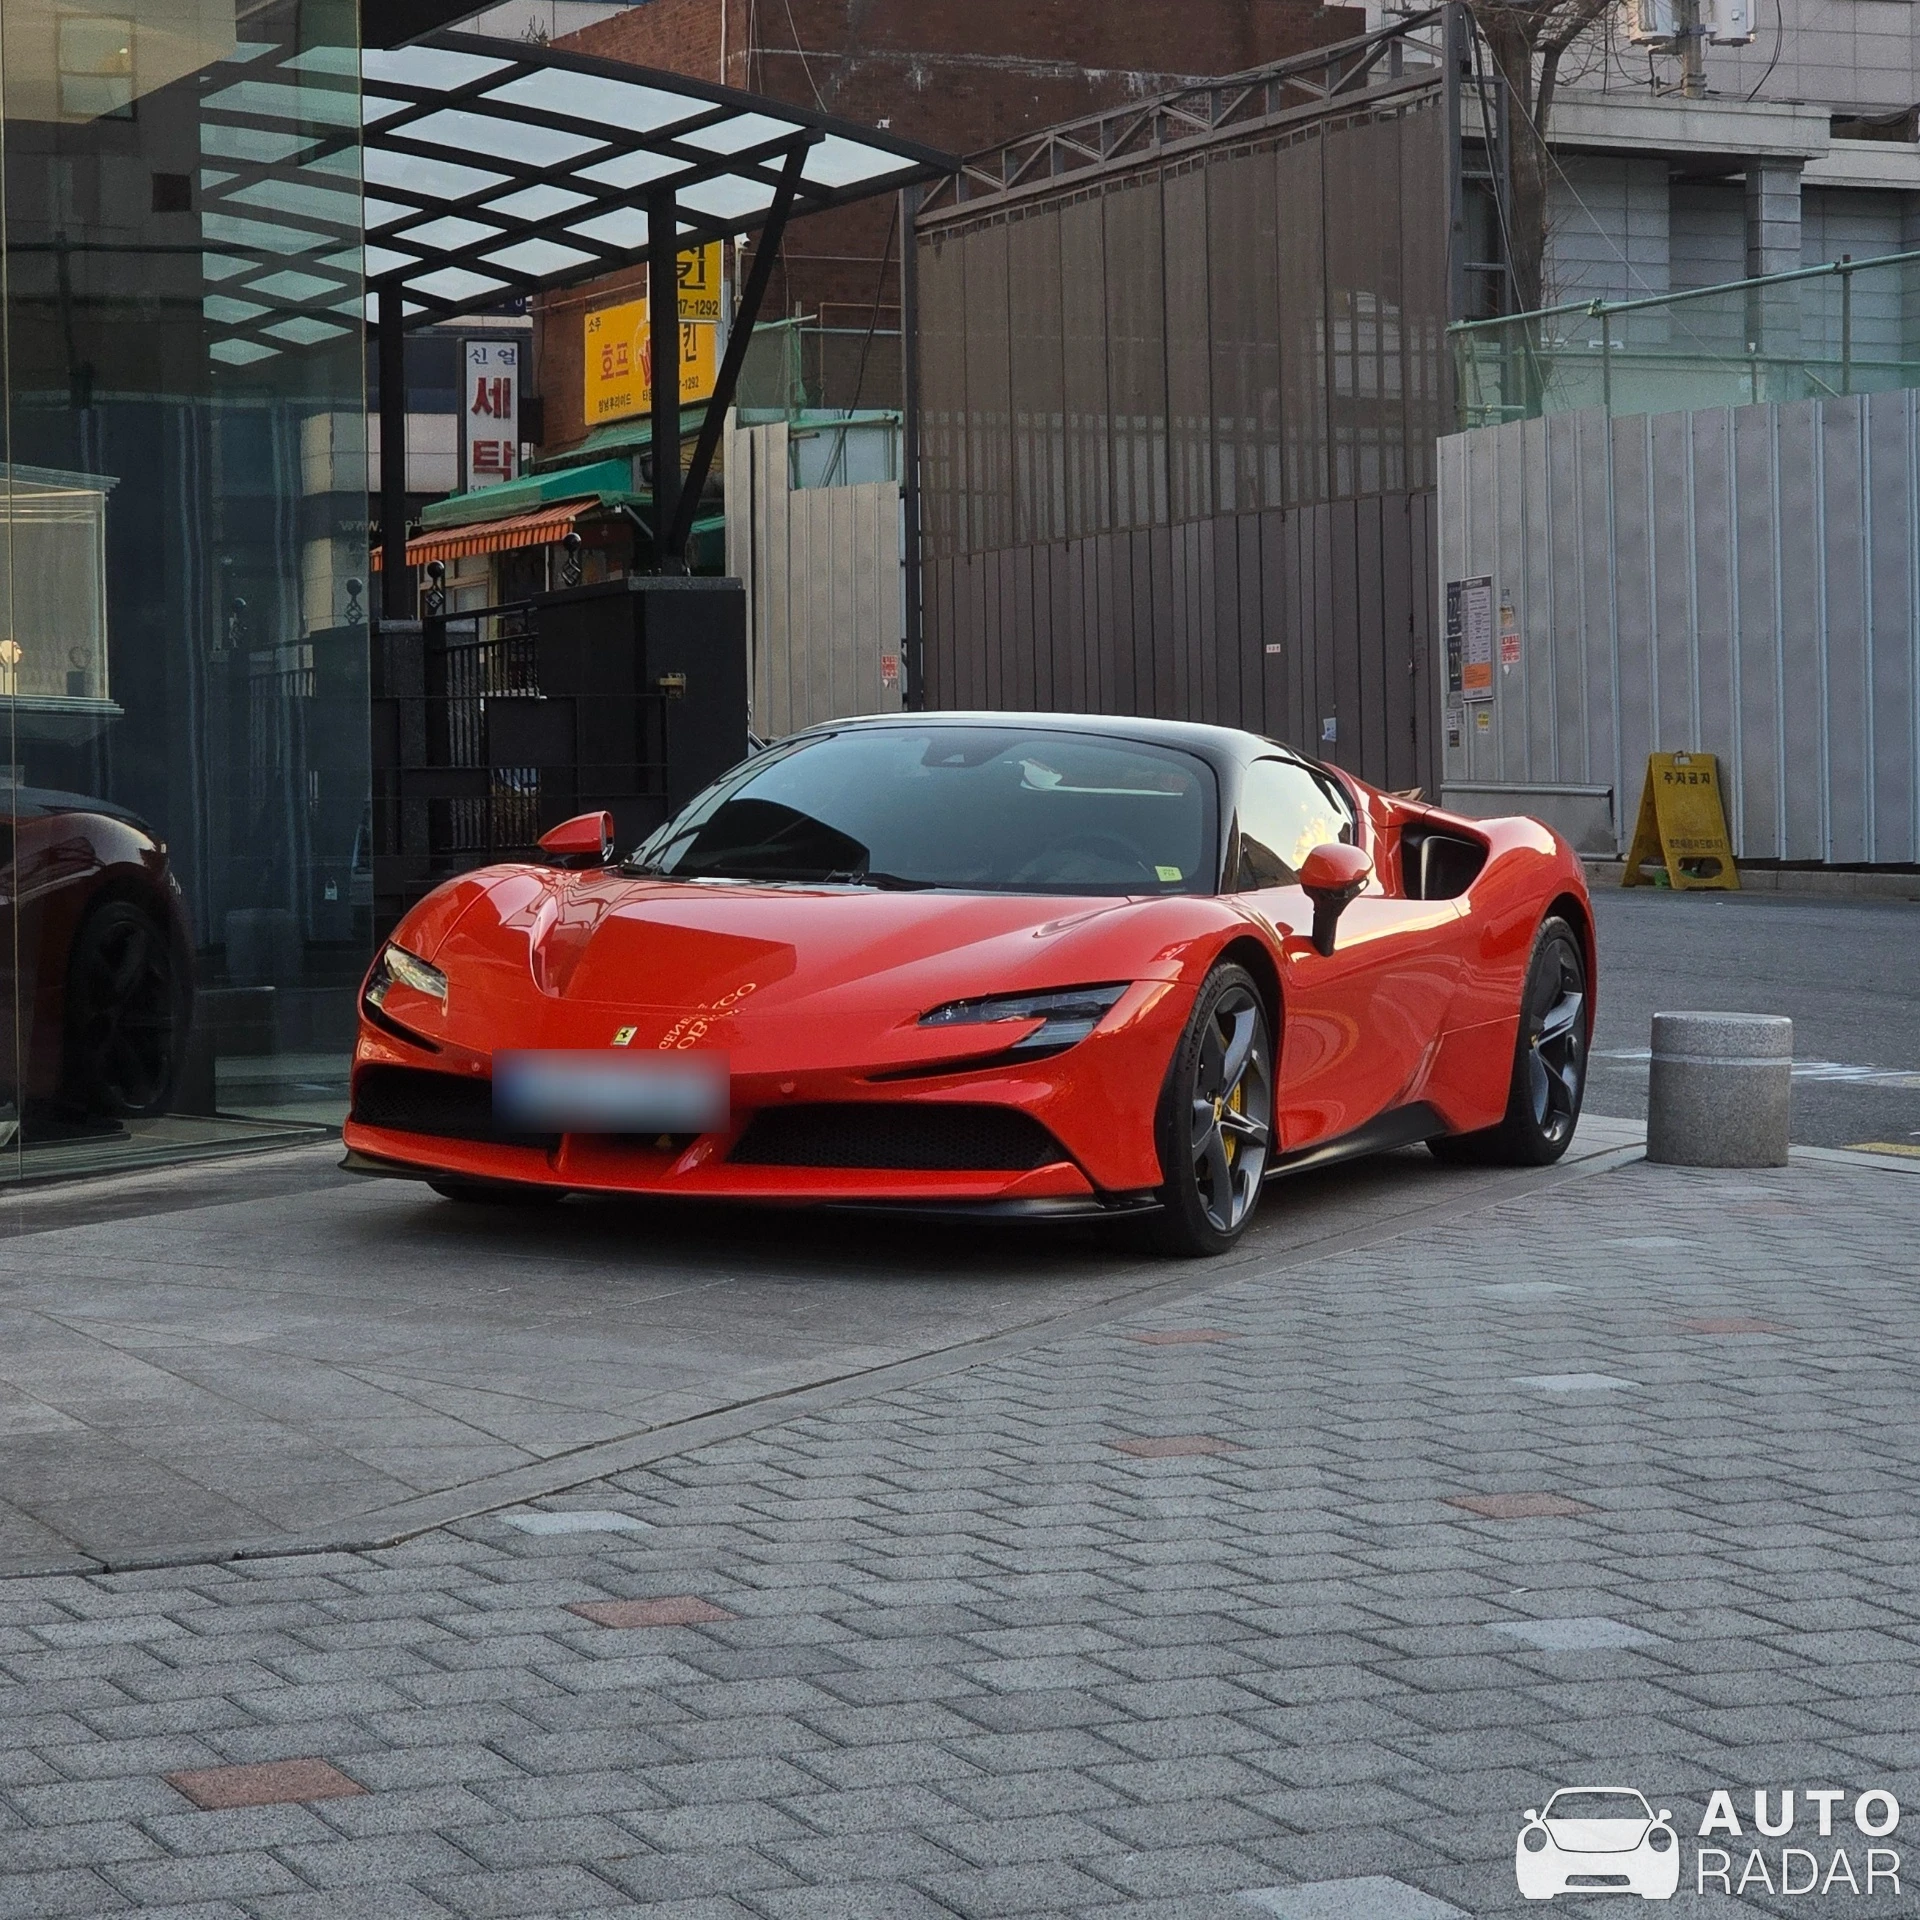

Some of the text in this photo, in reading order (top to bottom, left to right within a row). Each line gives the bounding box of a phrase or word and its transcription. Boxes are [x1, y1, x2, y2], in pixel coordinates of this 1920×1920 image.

[678, 299, 719, 316] 17-1292
[588, 317, 602, 333] 소주
[600, 342, 629, 381] 호프
[679, 376, 700, 391] -1292
[471, 377, 516, 483] 세탁
